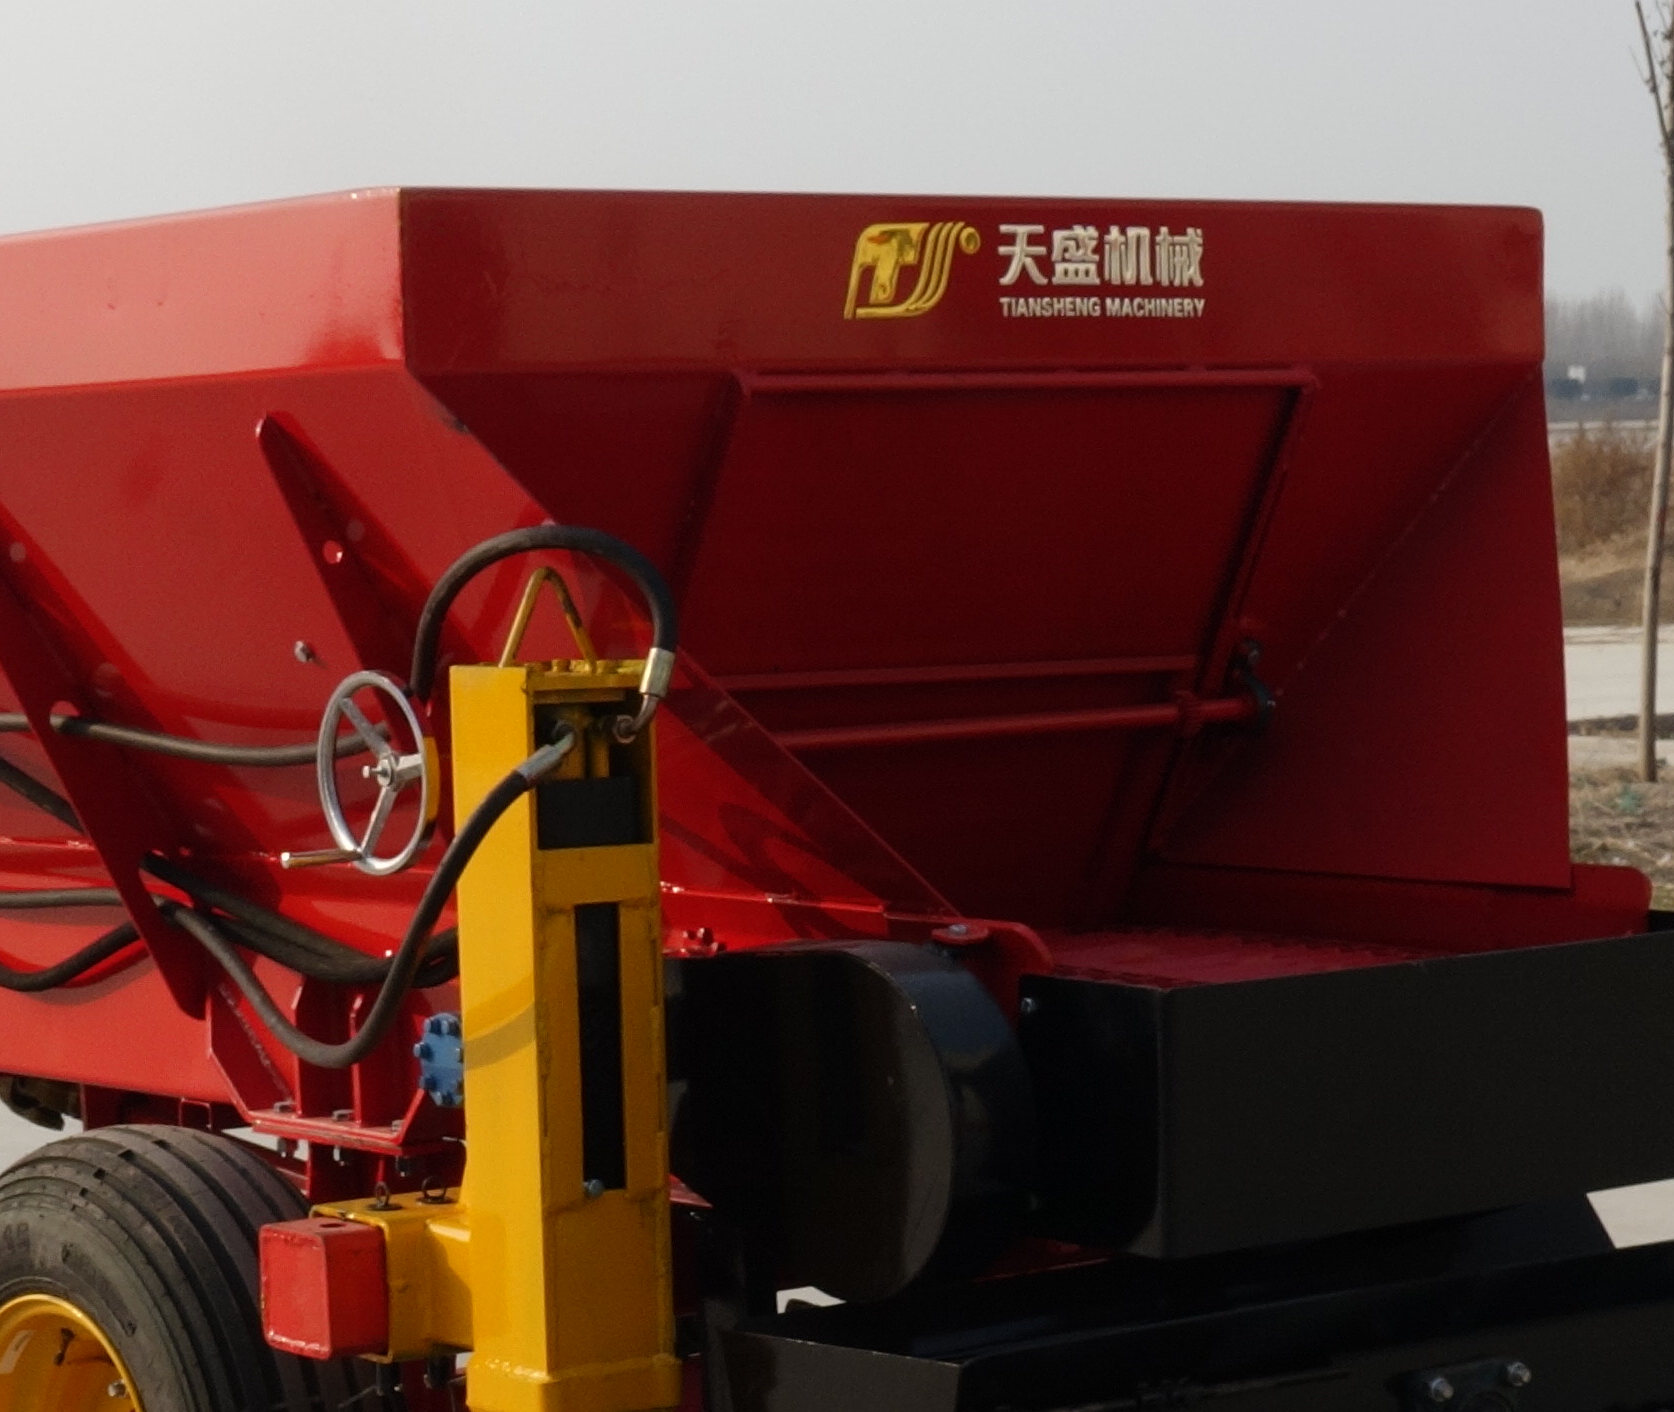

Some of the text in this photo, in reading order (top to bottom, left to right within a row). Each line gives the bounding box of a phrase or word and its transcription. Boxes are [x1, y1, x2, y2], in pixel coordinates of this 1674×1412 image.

[998, 224, 1204, 287] 天盛机械
[999, 297, 1205, 318] TIANSHENG MACHINERY
